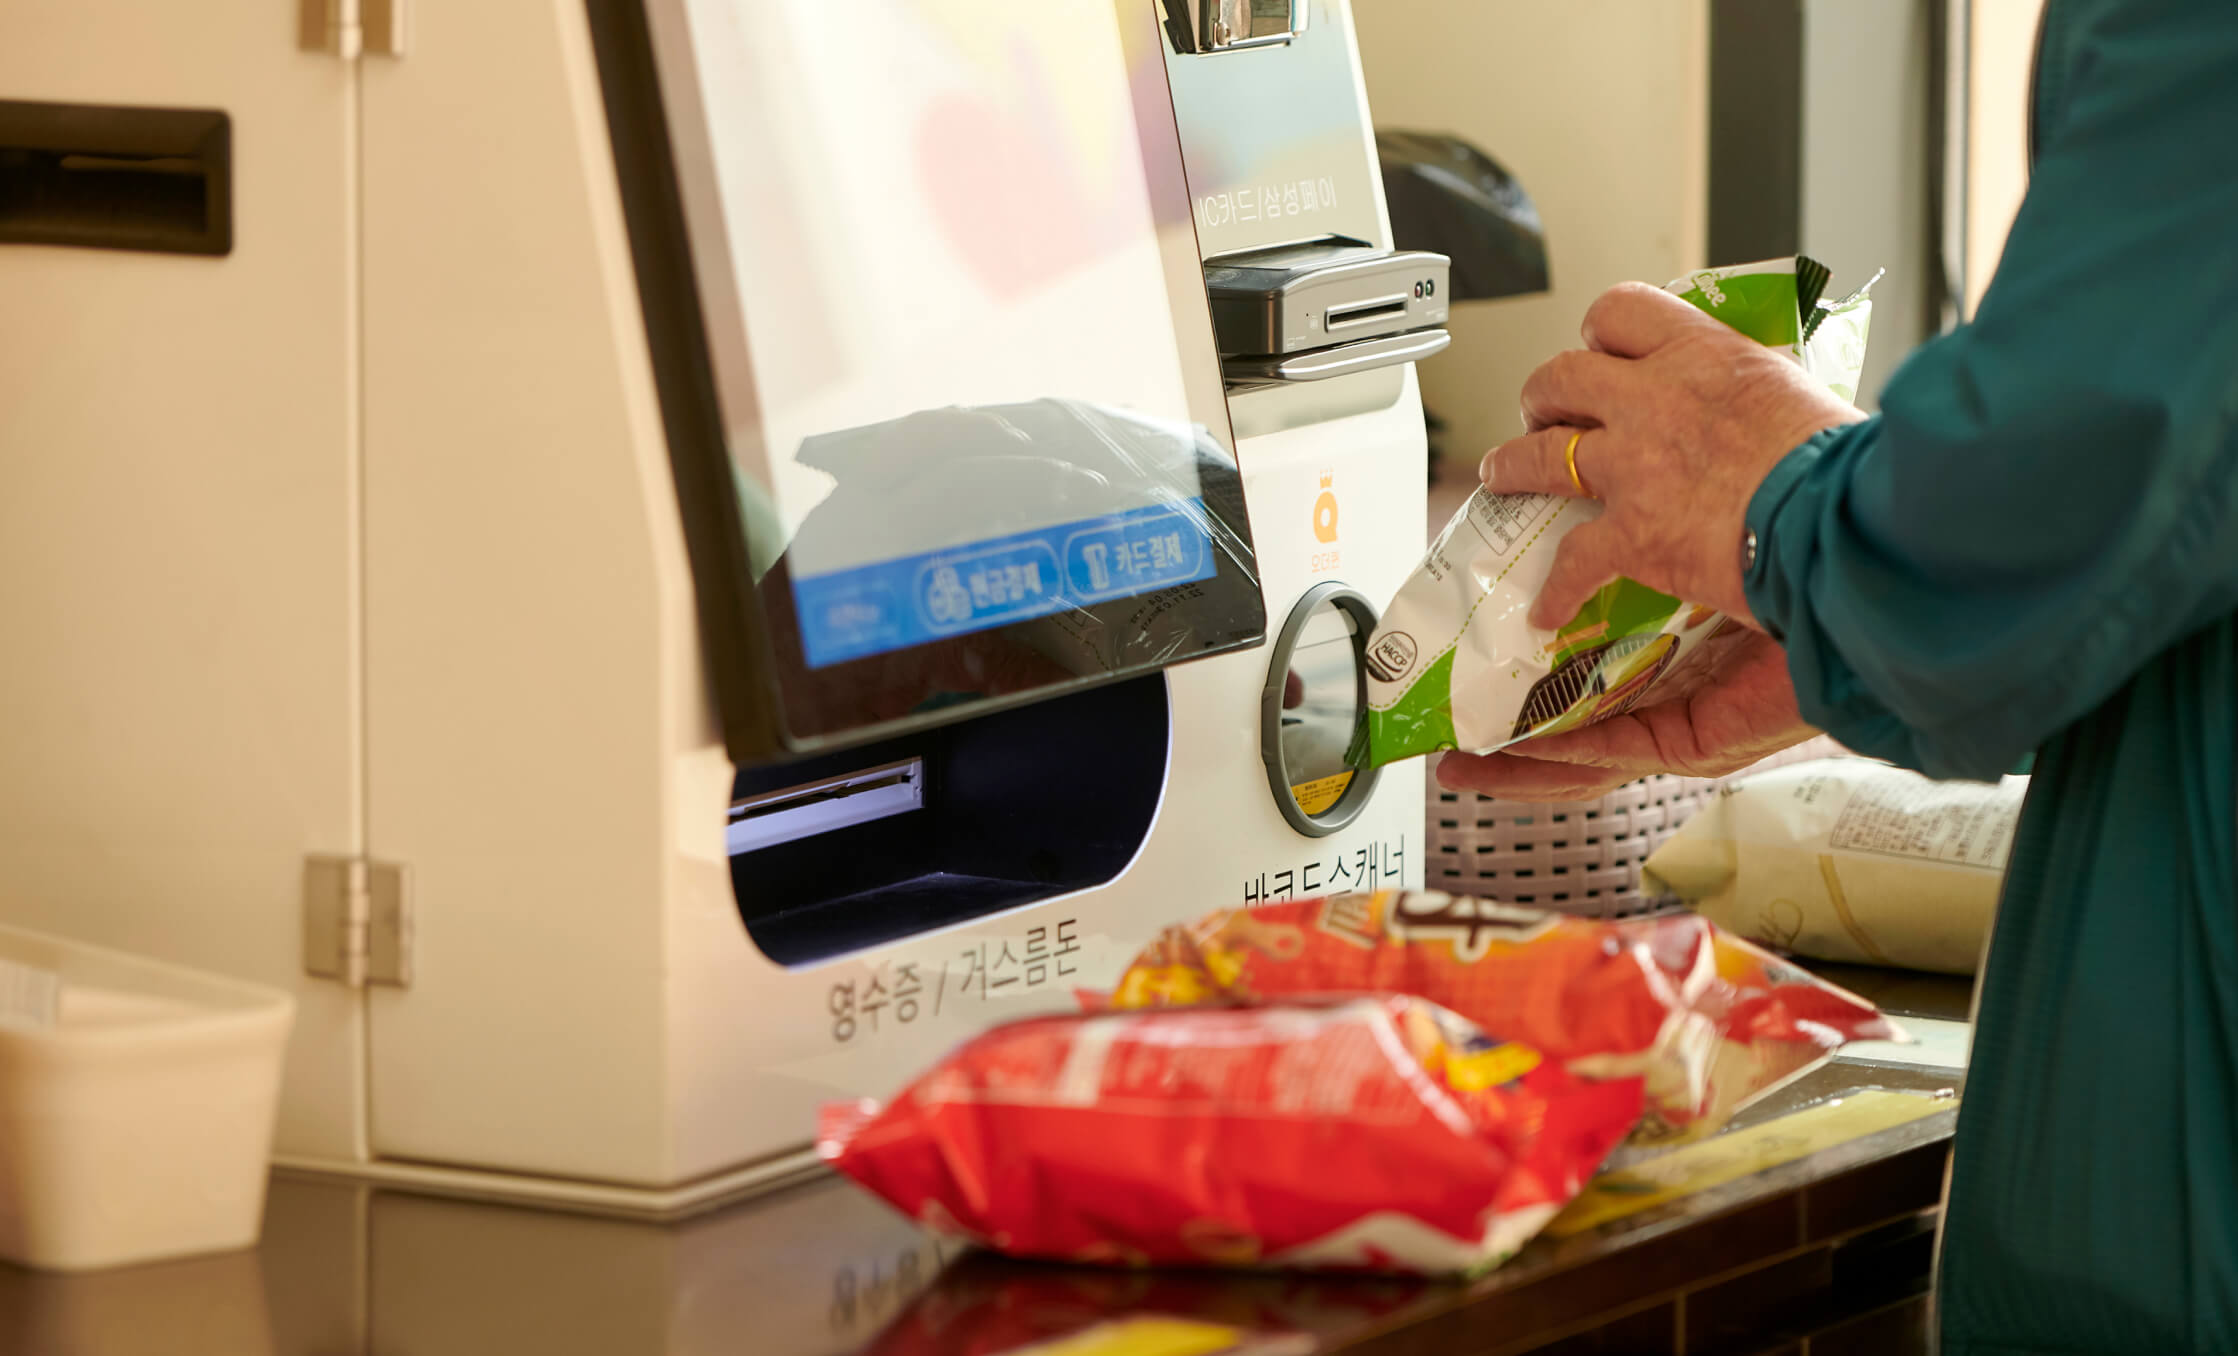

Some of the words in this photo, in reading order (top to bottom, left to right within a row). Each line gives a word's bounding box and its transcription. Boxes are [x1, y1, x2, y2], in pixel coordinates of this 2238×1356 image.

[1198, 176, 1337, 227] IC카드/삼성페이
[1114, 532, 1184, 575] 카드결제
[1381, 641, 1408, 666] HACCP
[829, 961, 922, 1043] 영수증
[933, 960, 949, 1017] /
[960, 918, 1081, 1001] 거스름돈
